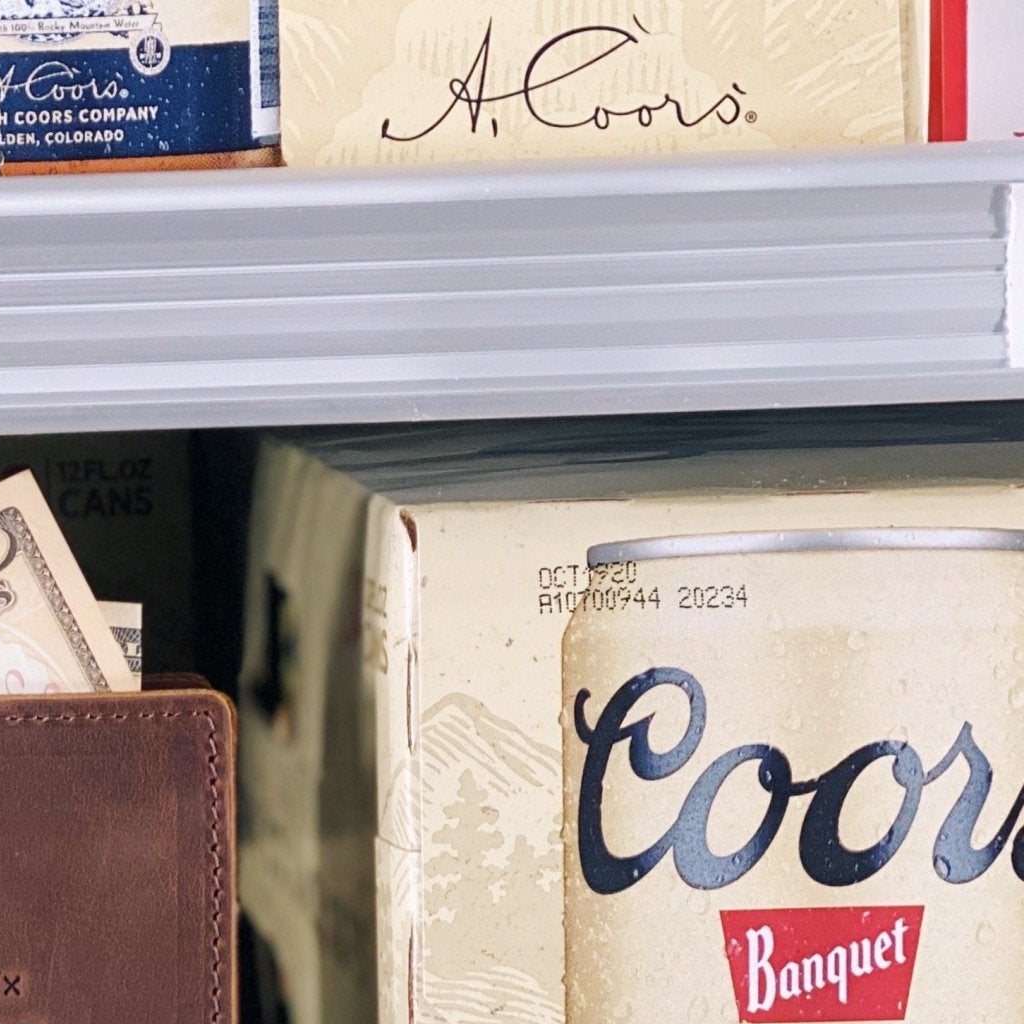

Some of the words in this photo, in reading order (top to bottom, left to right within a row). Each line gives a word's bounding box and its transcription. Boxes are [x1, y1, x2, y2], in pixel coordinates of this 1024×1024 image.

[14, 109, 73, 125] COORS
[79, 105, 158, 123] COMPANY
[44, 128, 124, 145] COLORADO
[58, 486, 154, 517] CANS
[678, 584, 748, 609] 20234
[746, 917, 908, 1014] Banquet
